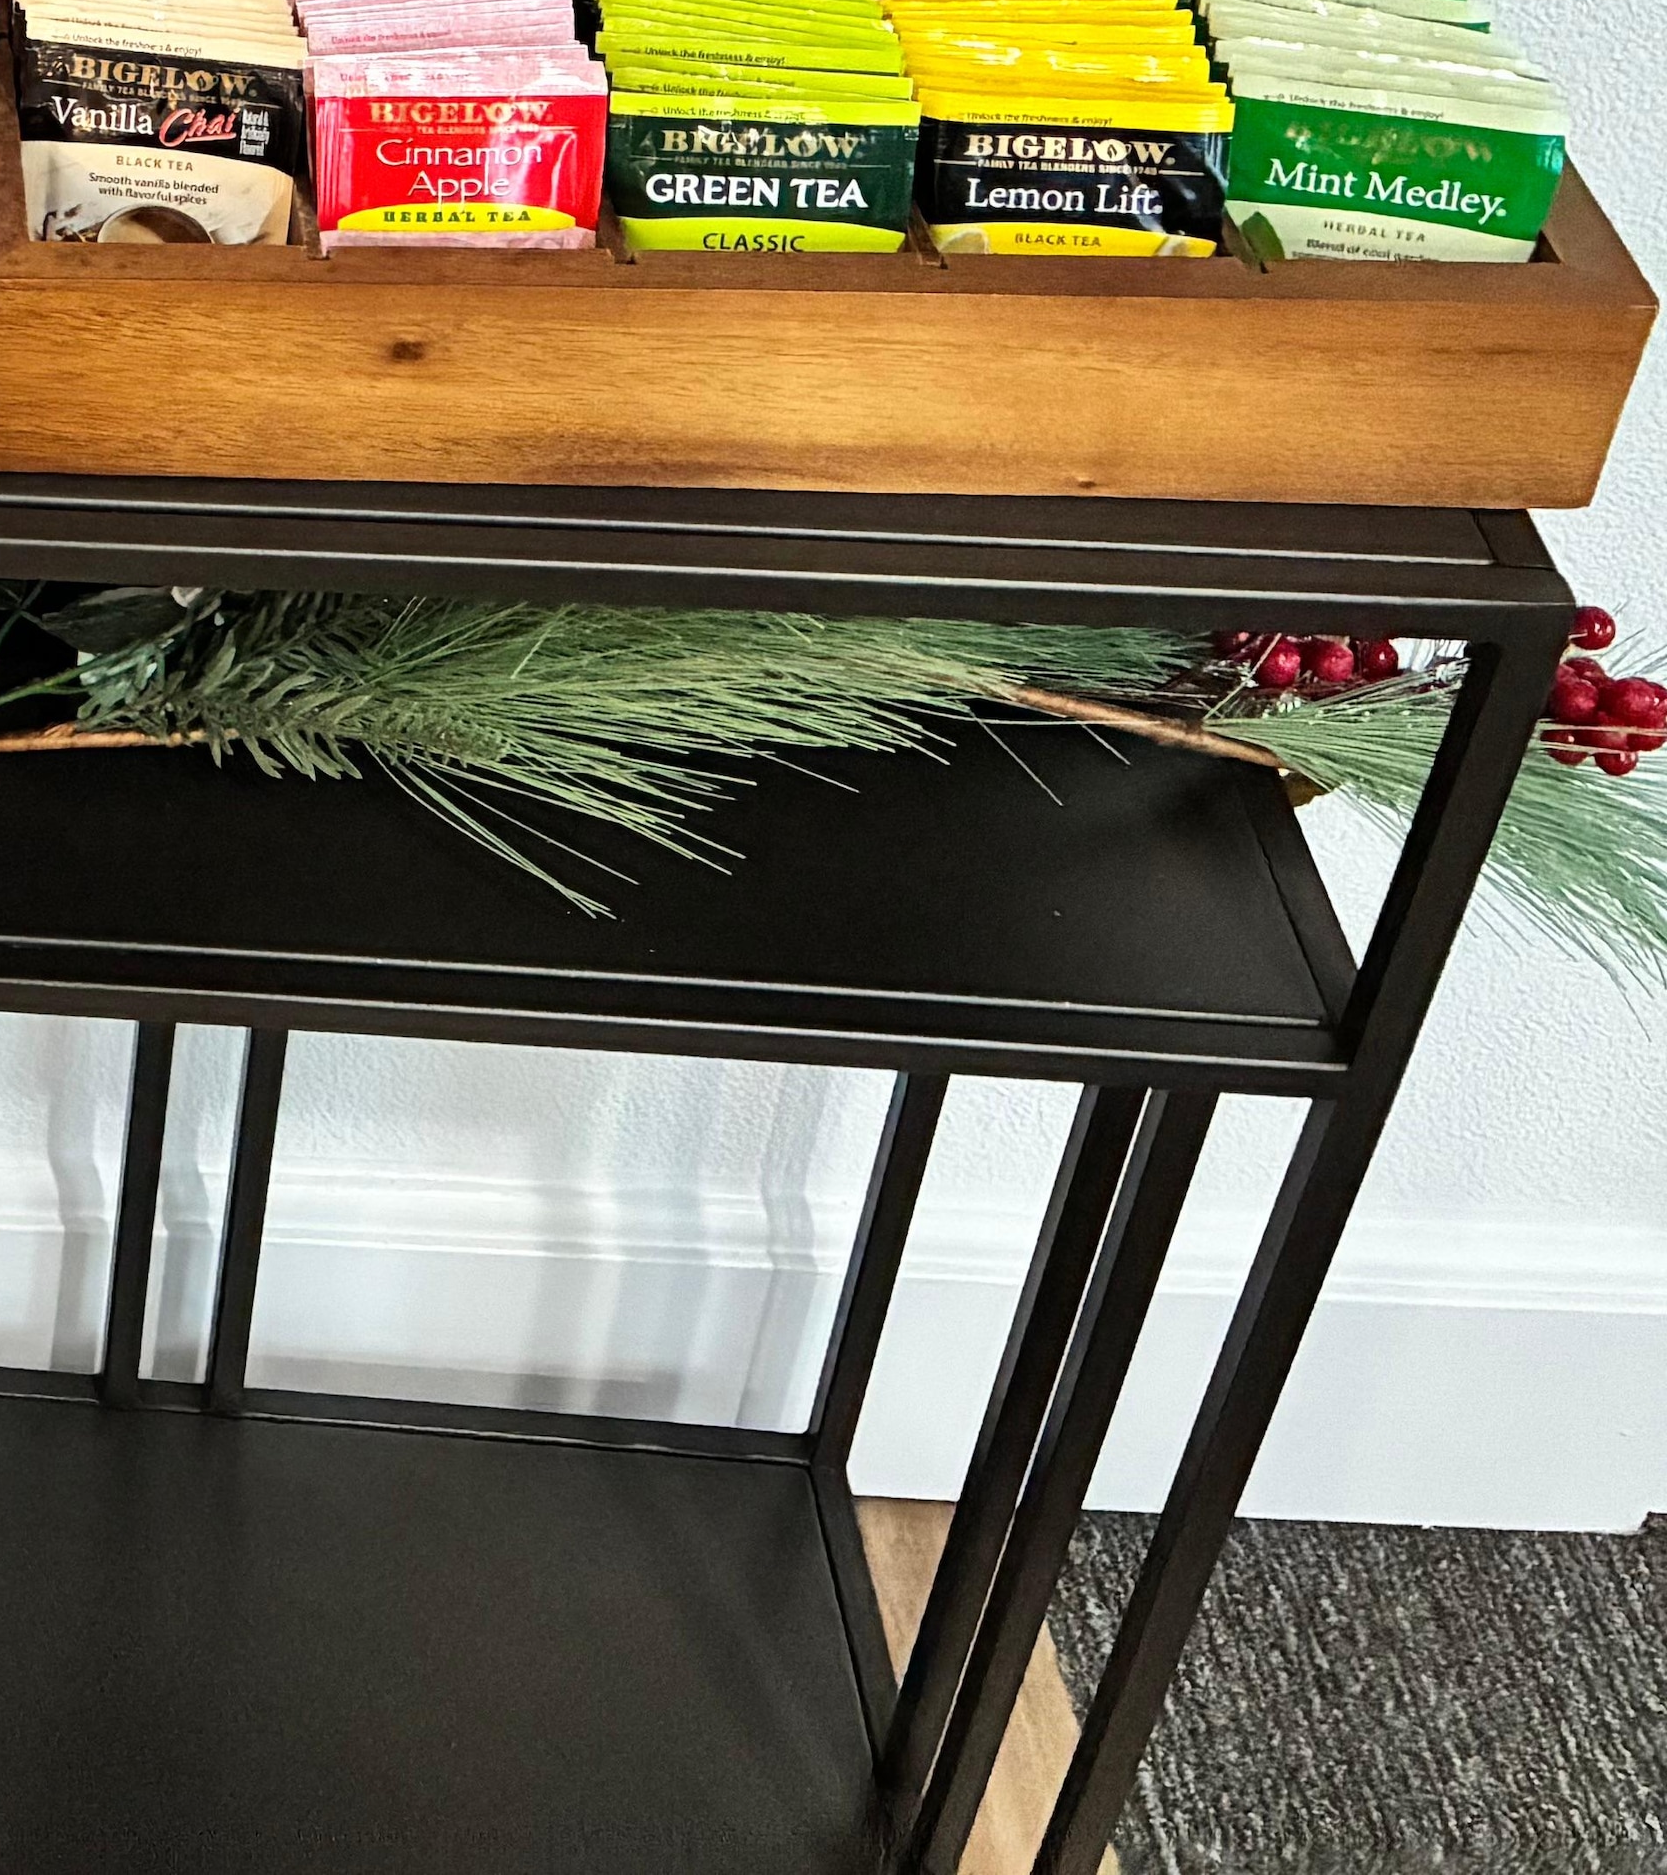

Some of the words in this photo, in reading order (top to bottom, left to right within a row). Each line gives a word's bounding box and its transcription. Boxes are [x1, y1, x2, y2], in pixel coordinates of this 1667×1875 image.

[73, 34, 103, 44] Unlock
[105, 37, 120, 46] the
[122, 39, 163, 51] freshnes
[174, 46, 202, 57] enjoy!
[645, 47, 677, 57] Unlock
[679, 49, 697, 59] the
[69, 52, 252, 96] BIGELOW
[117, 86, 134, 95] TEA
[52, 96, 154, 136] Vanilla
[159, 106, 241, 148] Chai
[370, 101, 553, 124] BIGELOW
[376, 138, 542, 166] Cinnamon
[660, 128, 860, 159] BIGELOW
[964, 134, 1176, 164] BIGELOW
[116, 155, 162, 169] BLACK
[168, 159, 194, 172] TEA
[1019, 160, 1038, 171] TEA
[1041, 161, 1096, 173] BLENDERS
[89, 173, 132, 187] Smooth
[134, 176, 171, 190] vanilla
[173, 179, 219, 194] blended
[407, 171, 514, 213] Apple
[645, 173, 780, 208] GREEN
[790, 178, 868, 208] TEA
[1264, 158, 1357, 198] Mint
[1364, 172, 1505, 225] Medley
[98, 186, 123, 197] with
[125, 187, 173, 203] flavorful
[174, 191, 207, 206] spices
[965, 177, 1085, 212] Lemon
[1094, 183, 1157, 215] Lift
[383, 210, 476, 223] HERBAL
[487, 210, 531, 222] TEA
[1015, 232, 1066, 246] BLACK
[1071, 236, 1102, 247] TEA
[1324, 220, 1387, 239] HERBAL
[1396, 230, 1425, 242] TEA
[703, 233, 805, 252] CLASSIC
[1307, 239, 1345, 253] Blend
[1347, 245, 1360, 254] of
